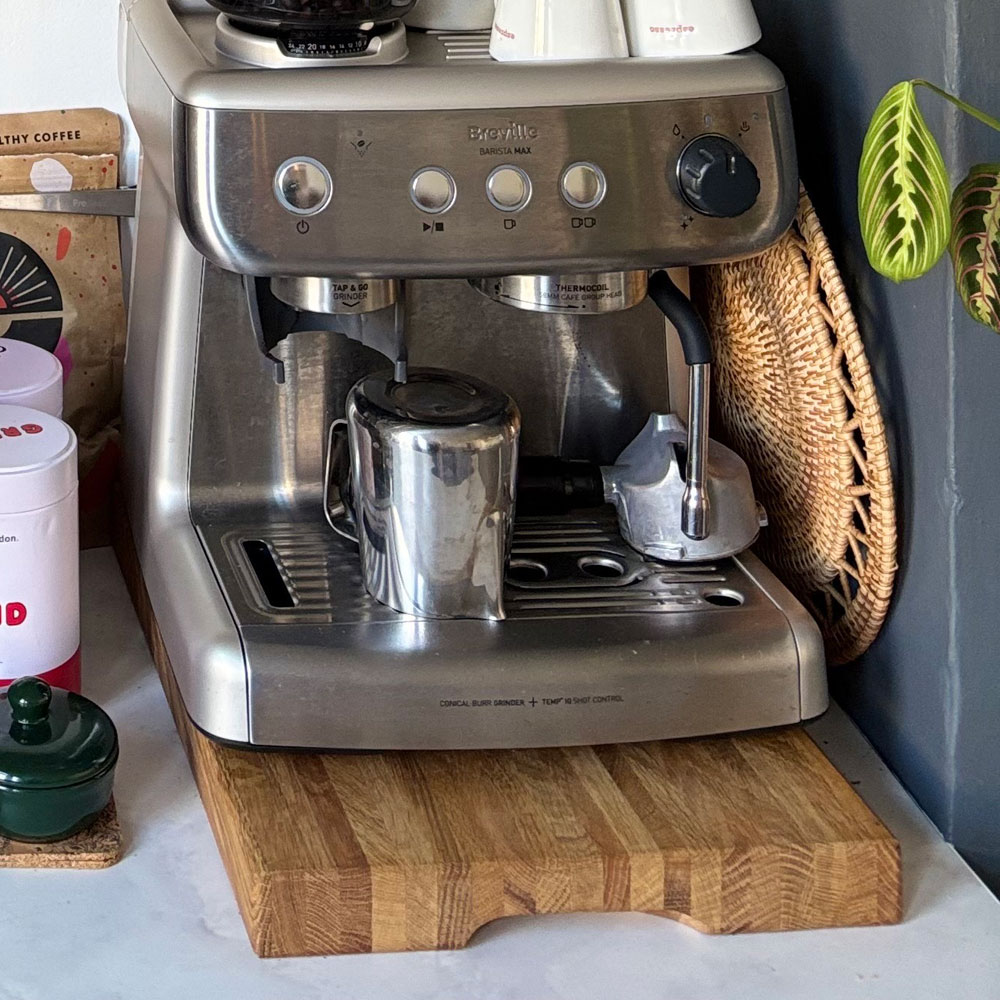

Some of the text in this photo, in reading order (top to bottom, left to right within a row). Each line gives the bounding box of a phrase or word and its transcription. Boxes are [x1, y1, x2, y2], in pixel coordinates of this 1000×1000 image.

[34, 130, 82, 143] COFFEE
[468, 121, 539, 141] Breville
[479, 146, 532, 156] BARISTA MAX
[332, 282, 369, 293] TAP & GO
[555, 283, 610, 293] THERMOCOIL
[333, 292, 368, 301] GRINDER
[439, 699, 471, 708] CONICAL
[472, 699, 493, 707] BURR
[493, 699, 526, 707] GRINDER
[592, 695, 625, 704] CONTROL
